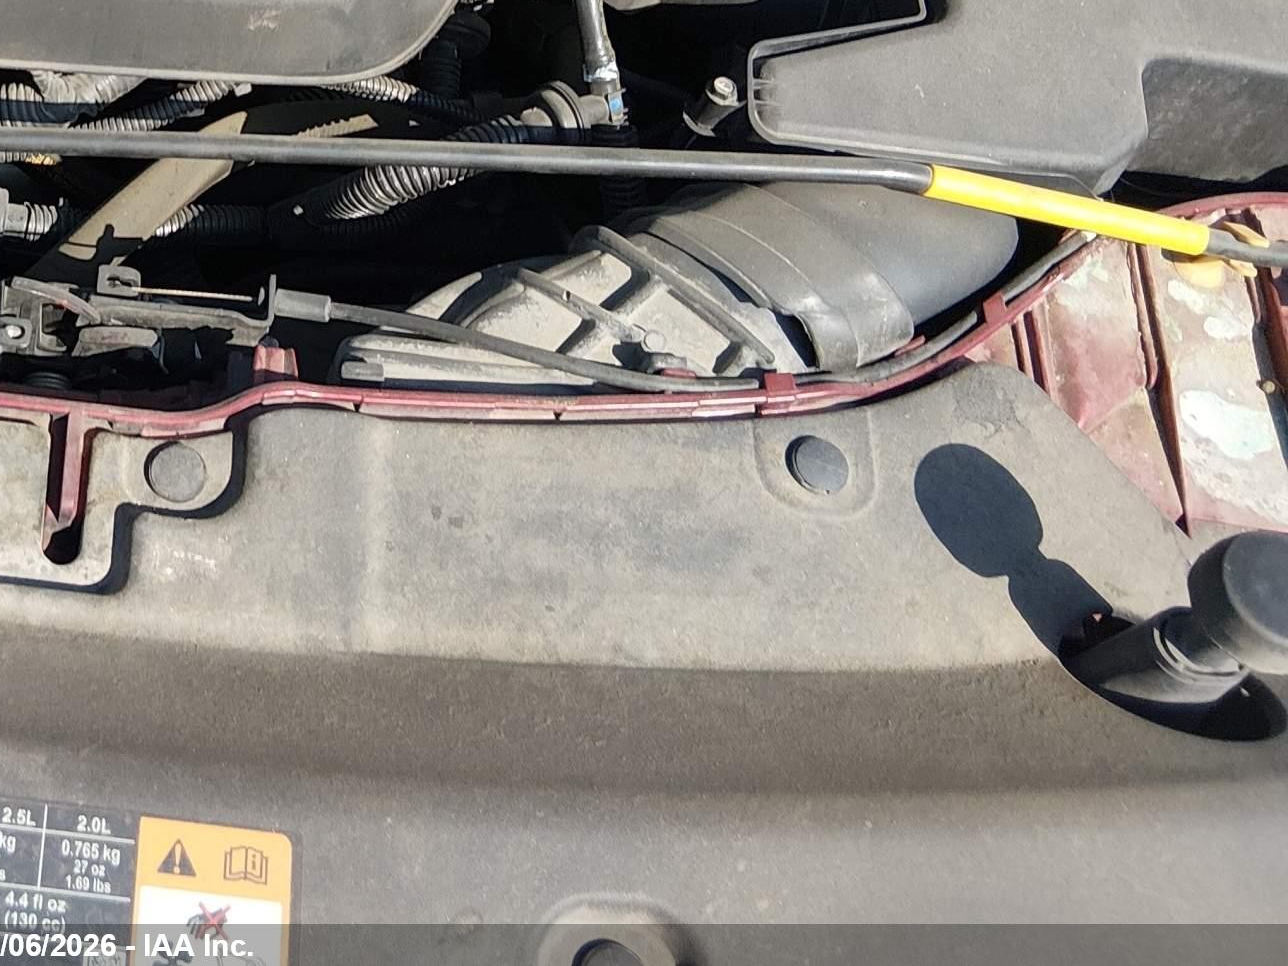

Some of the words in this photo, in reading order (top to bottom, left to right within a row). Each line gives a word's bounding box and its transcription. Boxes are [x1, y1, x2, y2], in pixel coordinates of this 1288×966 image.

[2, 807, 36, 827] 2.5L
[77, 814, 111, 835] 2.0L
[62, 838, 100, 860] 0.765
[103, 844, 121, 867] kg
[73, 859, 89, 875] 27
[91, 864, 106, 876] oz
[92, 877, 112, 894] lbs
[4, 890, 28, 907] 4.4
[32, 893, 44, 910] fl
[47, 899, 67, 914] oz
[4, 911, 38, 931] (130
